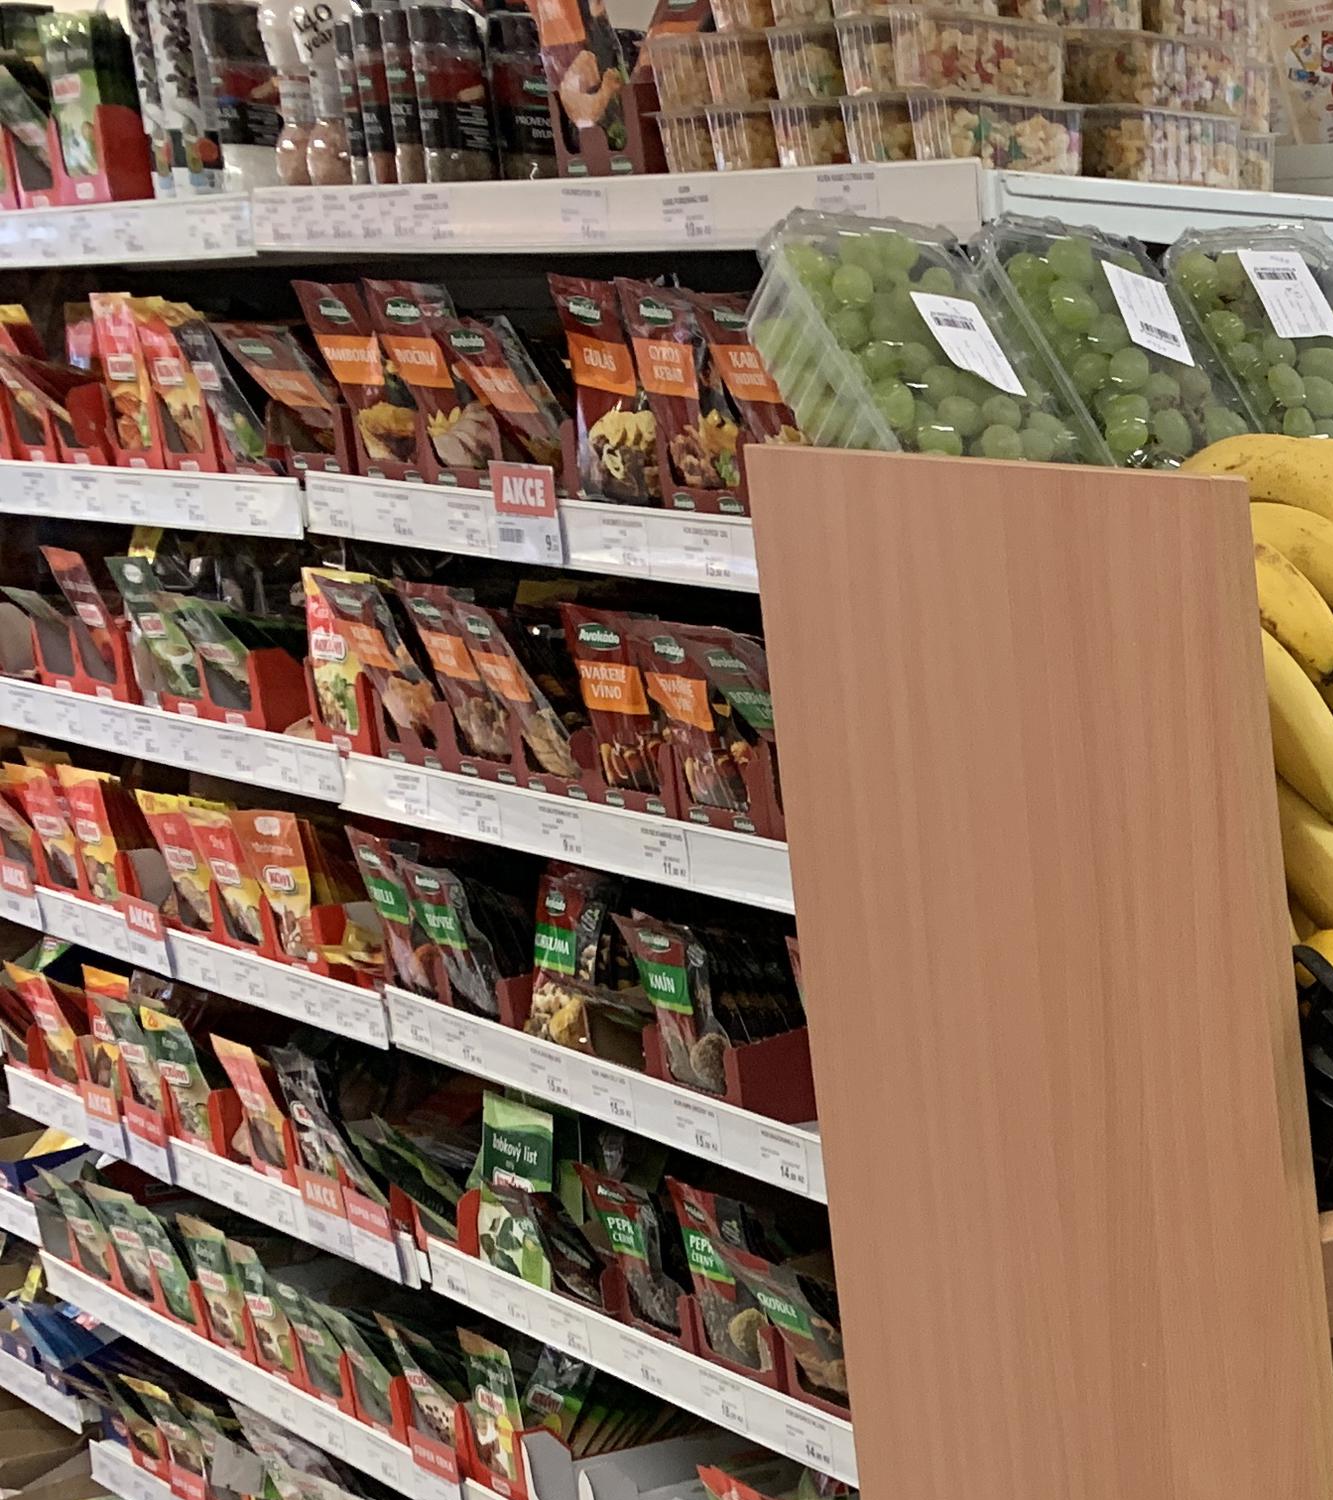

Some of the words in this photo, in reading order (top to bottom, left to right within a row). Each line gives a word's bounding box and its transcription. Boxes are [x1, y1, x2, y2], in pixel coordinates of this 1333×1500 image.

[501, 476, 546, 509] AKCE
[578, 624, 621, 646] Avokádo
[590, 684, 622, 700] VÍNO
[648, 971, 676, 994] KMÍN
[524, 1150, 538, 1167] list
[305, 1180, 337, 1209] AKCE
